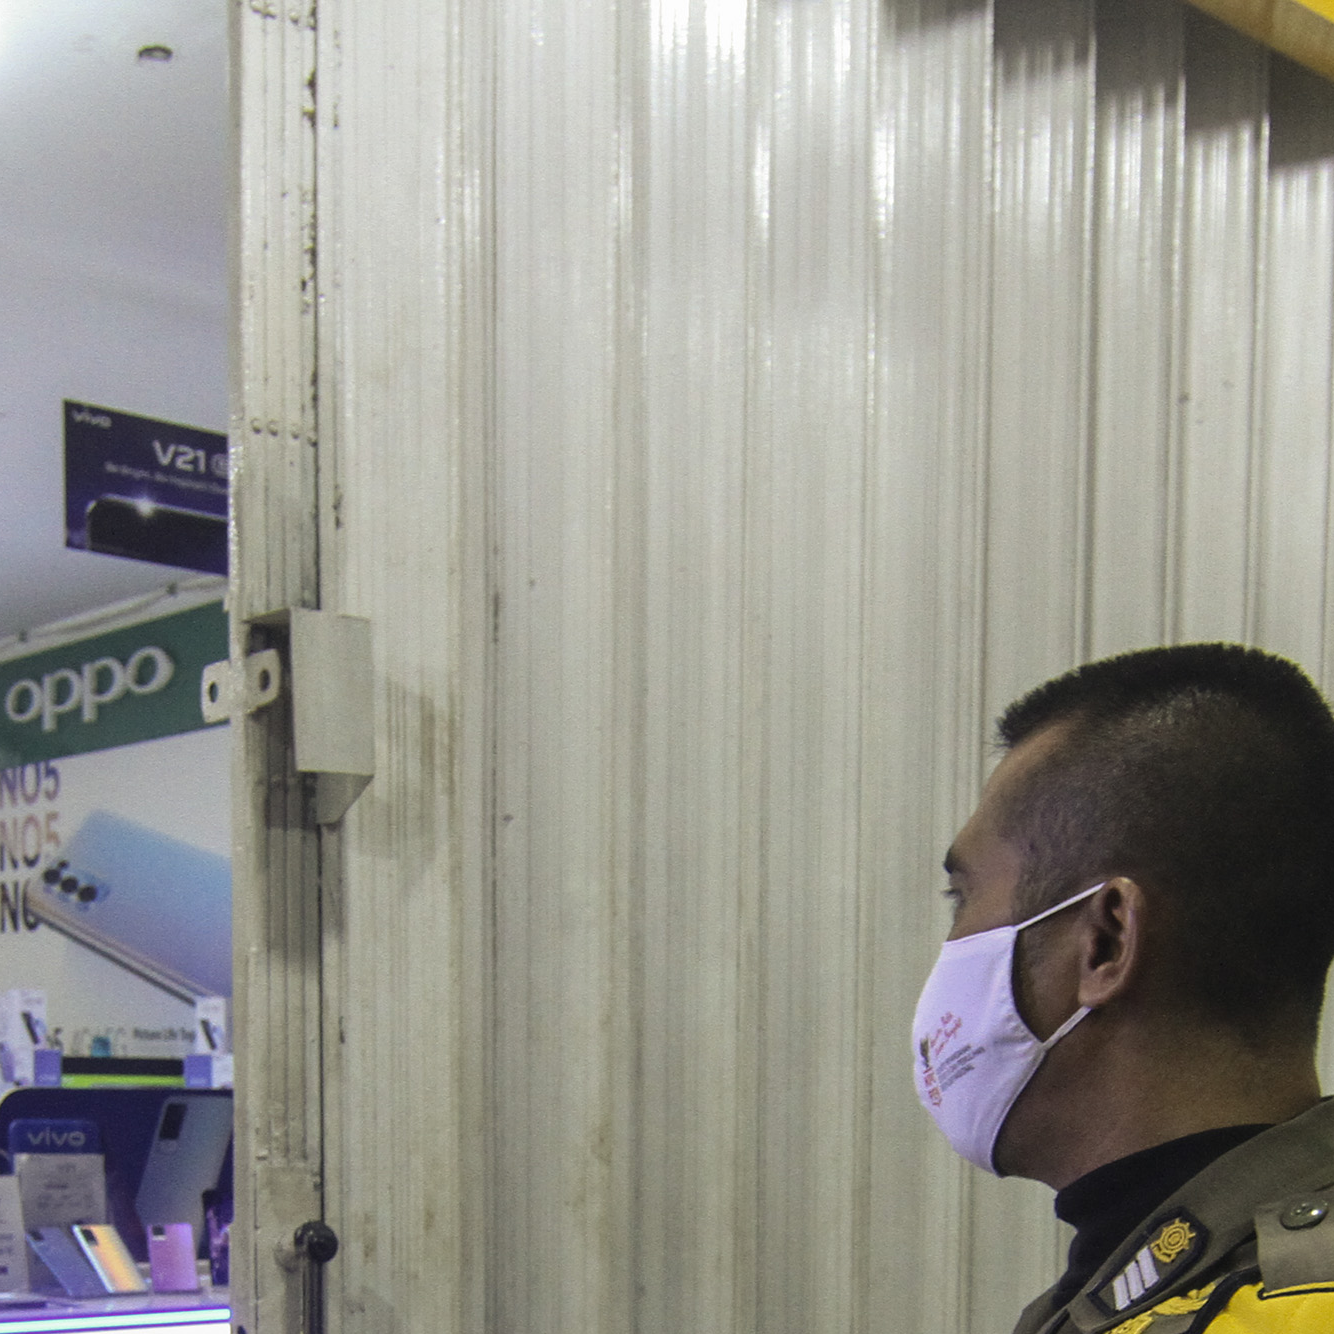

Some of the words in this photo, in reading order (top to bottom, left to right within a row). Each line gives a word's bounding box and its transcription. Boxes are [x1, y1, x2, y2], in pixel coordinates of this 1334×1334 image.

[152, 439, 206, 474] V21
[5, 646, 175, 733] oppo
[28, 1126, 86, 1148] vivo
